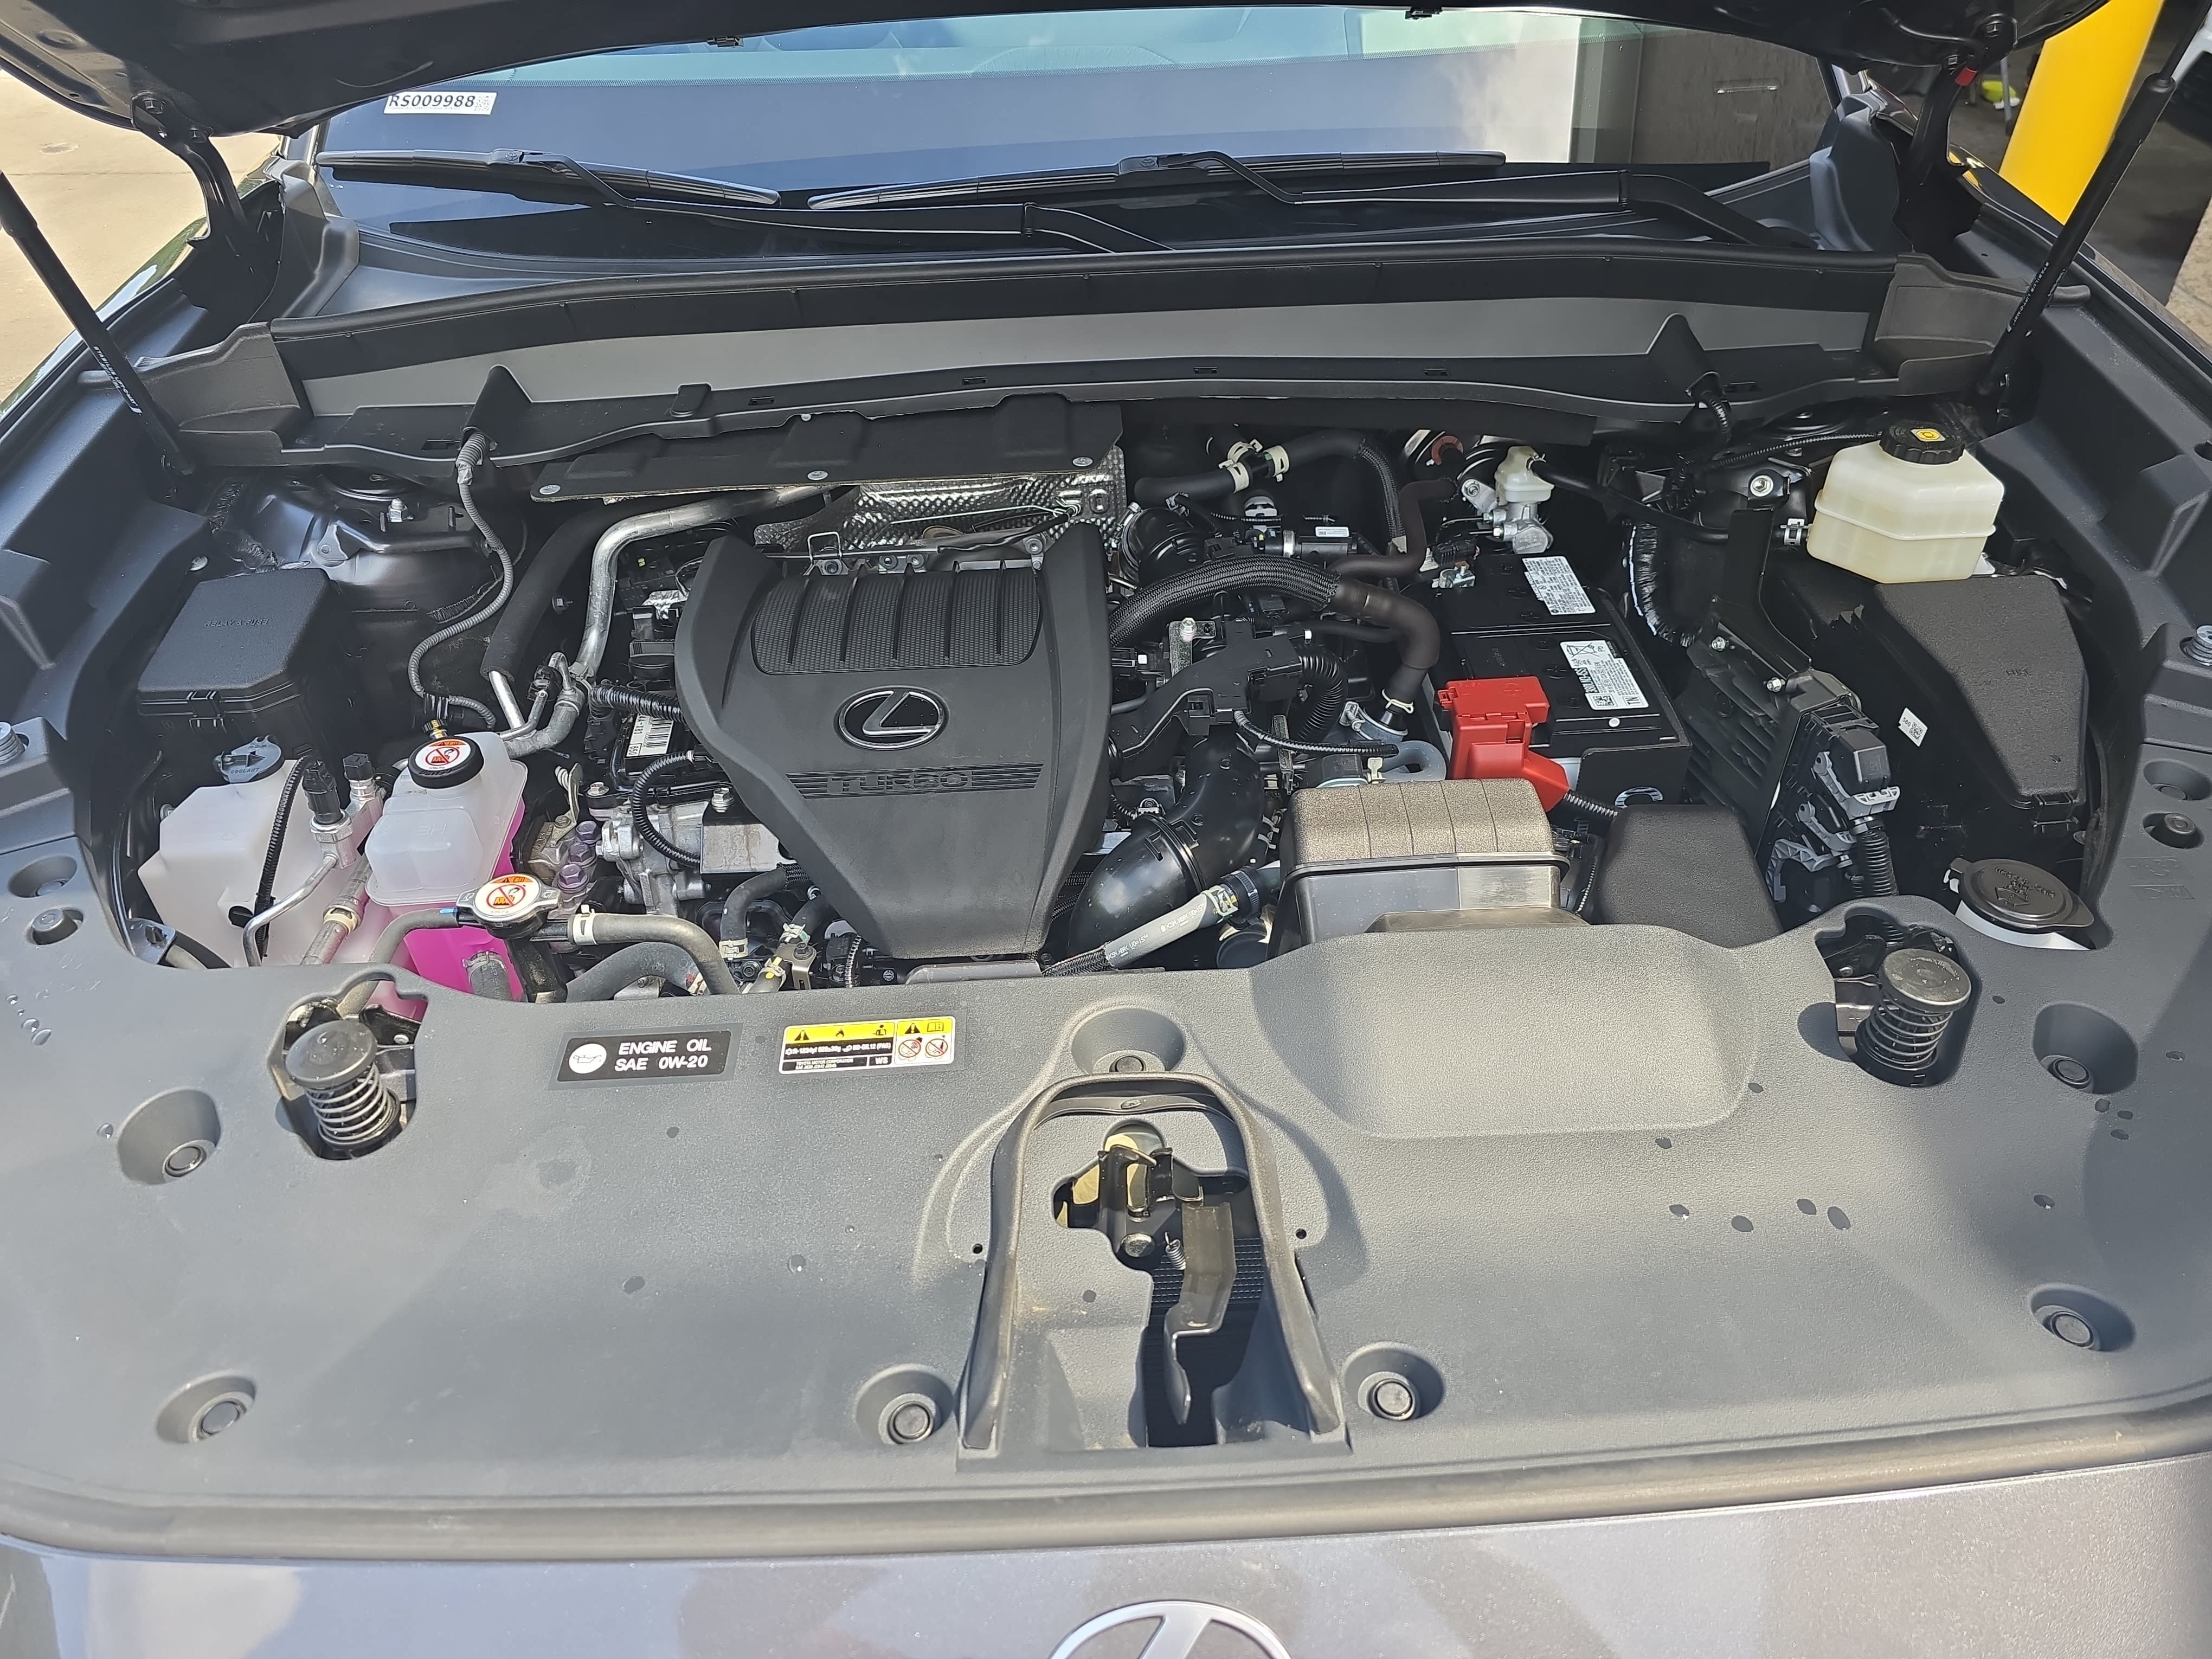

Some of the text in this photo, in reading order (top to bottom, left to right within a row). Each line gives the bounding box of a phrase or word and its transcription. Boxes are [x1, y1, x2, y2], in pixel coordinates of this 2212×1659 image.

[388, 94, 475, 107] RS009988
[1902, 717, 1911, 727] 560
[832, 771, 968, 793] TURBO
[618, 1038, 712, 1056] ENGINE OIL
[614, 1054, 709, 1072] SAE 0W-20
